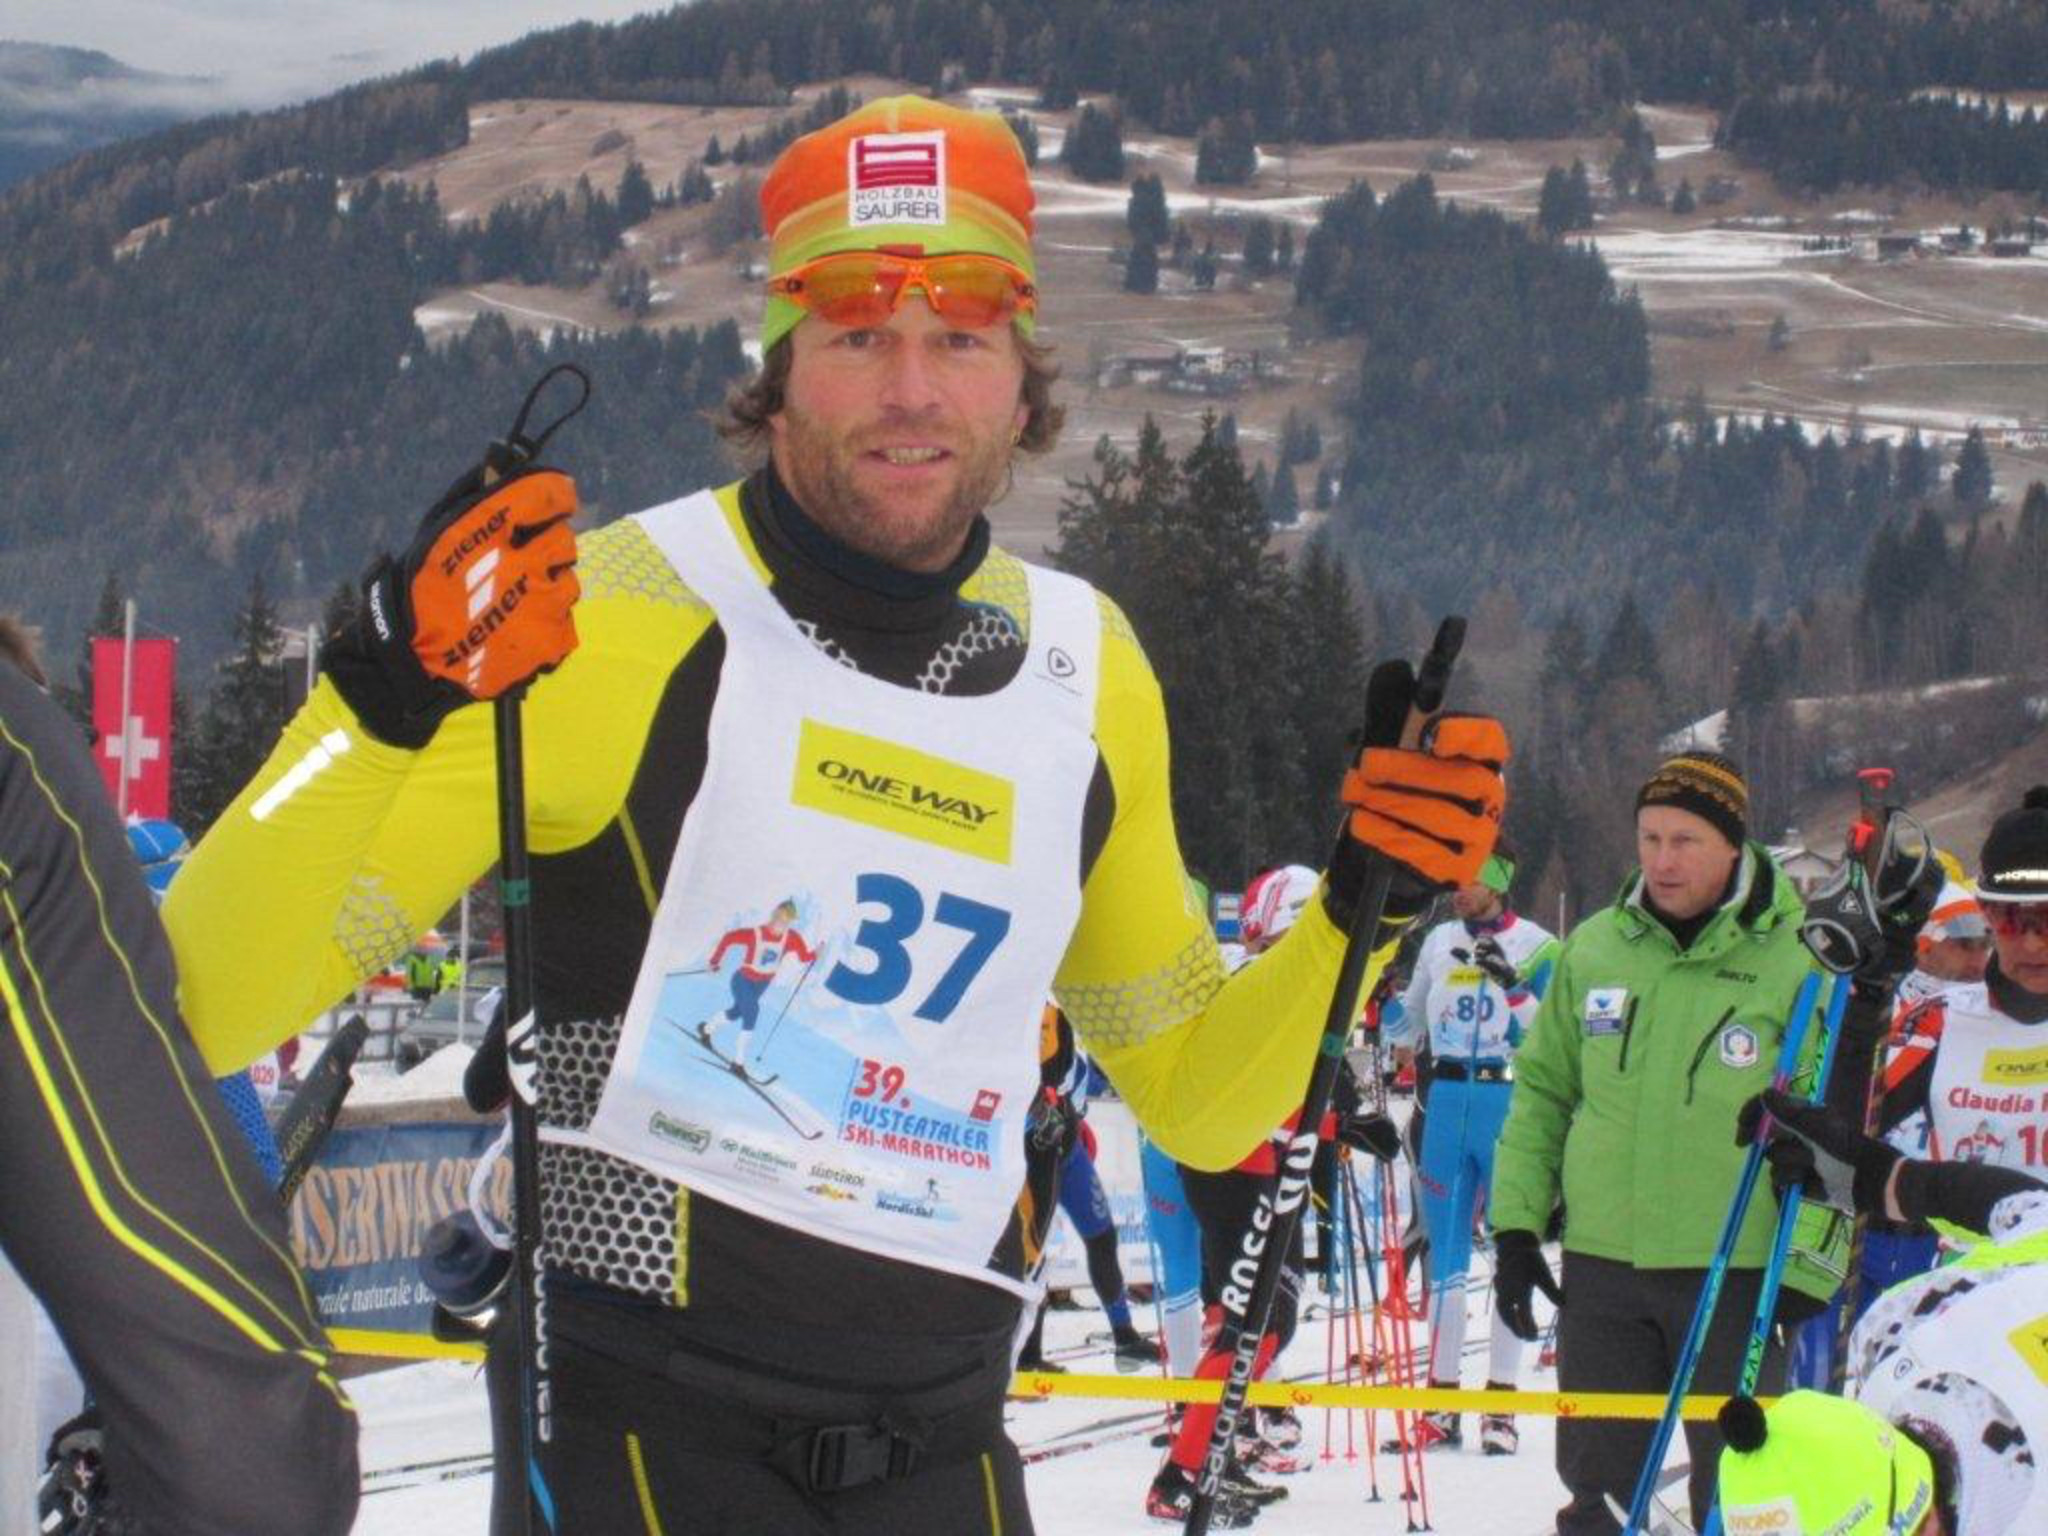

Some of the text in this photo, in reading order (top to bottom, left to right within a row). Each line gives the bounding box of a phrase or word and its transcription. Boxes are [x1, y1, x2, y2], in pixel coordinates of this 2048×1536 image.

[855, 187, 939, 203] HOLZBAU
[855, 201, 940, 221] SAURER
[441, 506, 510, 576] ziener
[443, 573, 528, 668] ziener
[816, 759, 909, 800] ONE
[911, 784, 998, 825] WAY
[824, 872, 1012, 1024] 37
[1456, 994, 1495, 1022] 80
[853, 1059, 911, 1109] 39.
[1949, 1087, 2034, 1114] Claudia
[844, 1123, 992, 1171] SKI-MARATHON
[849, 1100, 989, 1152] PUSTERTALER
[1198, 1331, 1261, 1497] salomon
